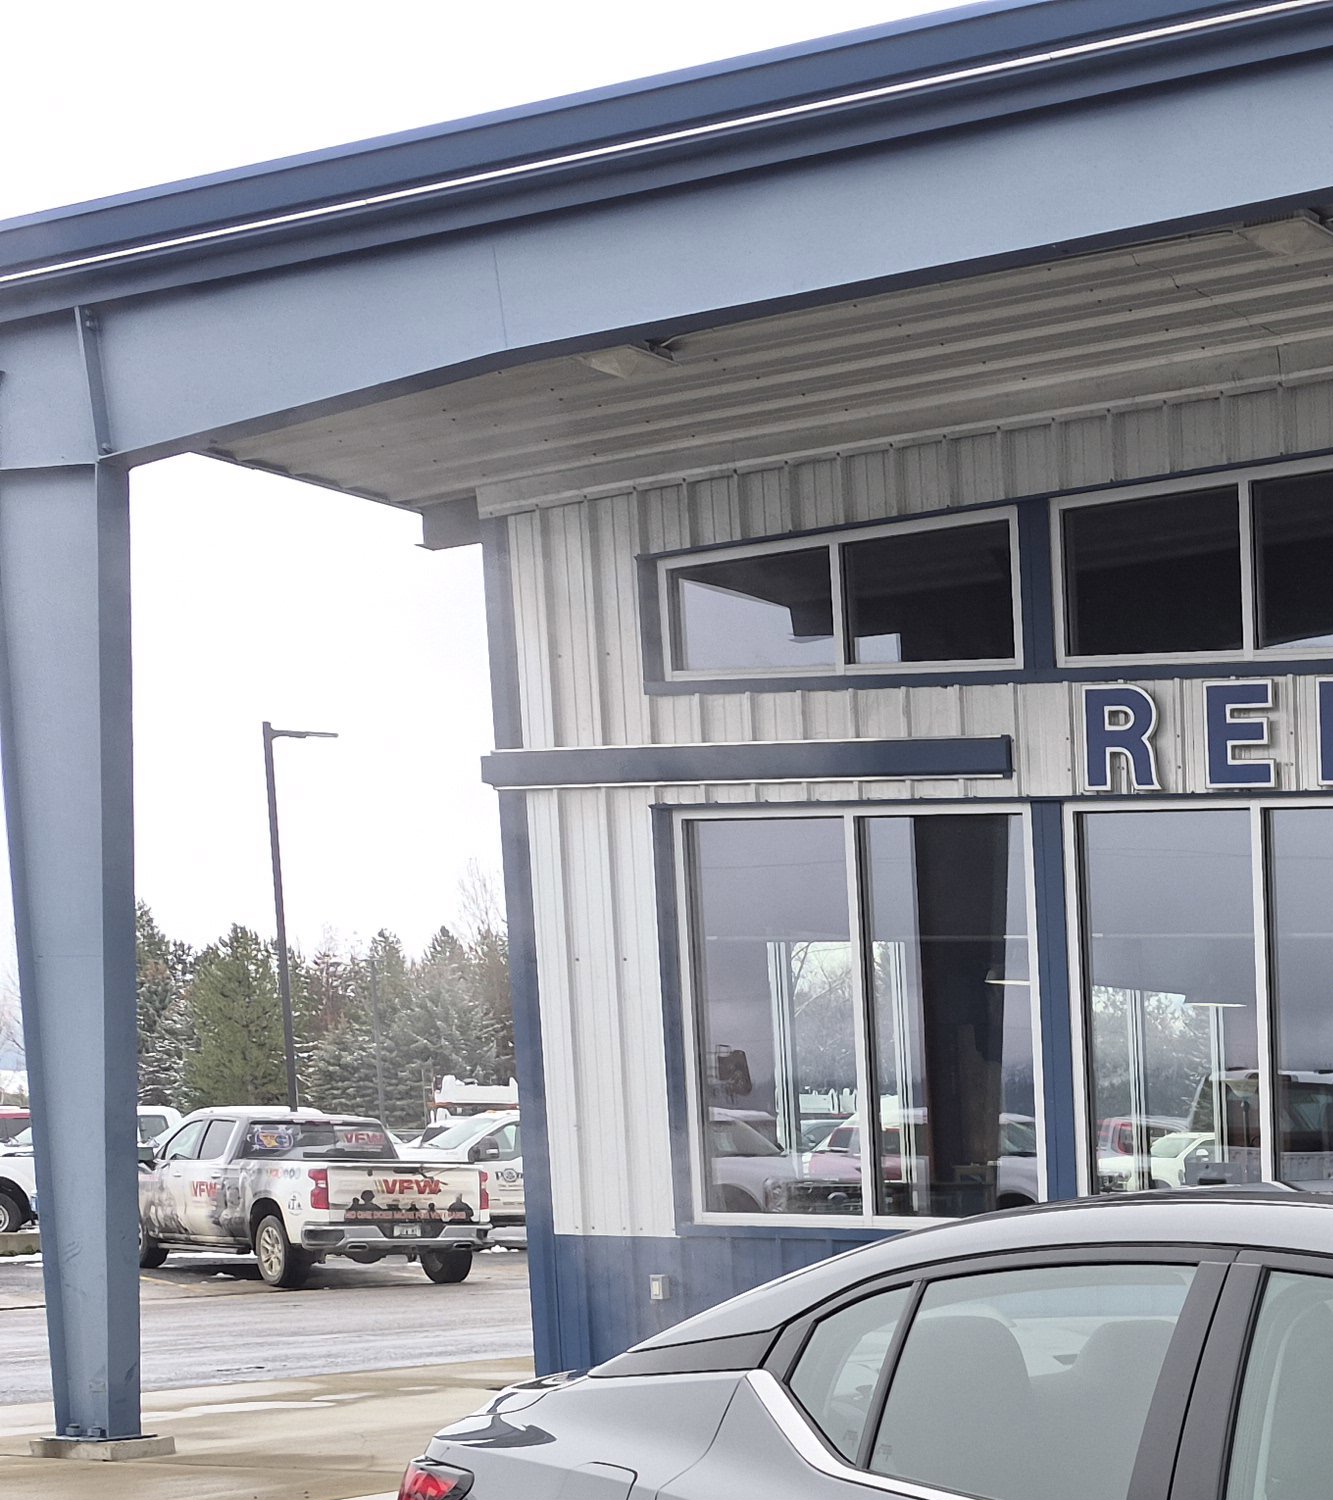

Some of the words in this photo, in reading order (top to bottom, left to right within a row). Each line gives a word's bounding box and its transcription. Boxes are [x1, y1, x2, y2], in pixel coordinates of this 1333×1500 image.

[344, 1131, 385, 1144] VFW
[192, 1180, 218, 1197] VFW
[382, 1179, 442, 1195] VFW
